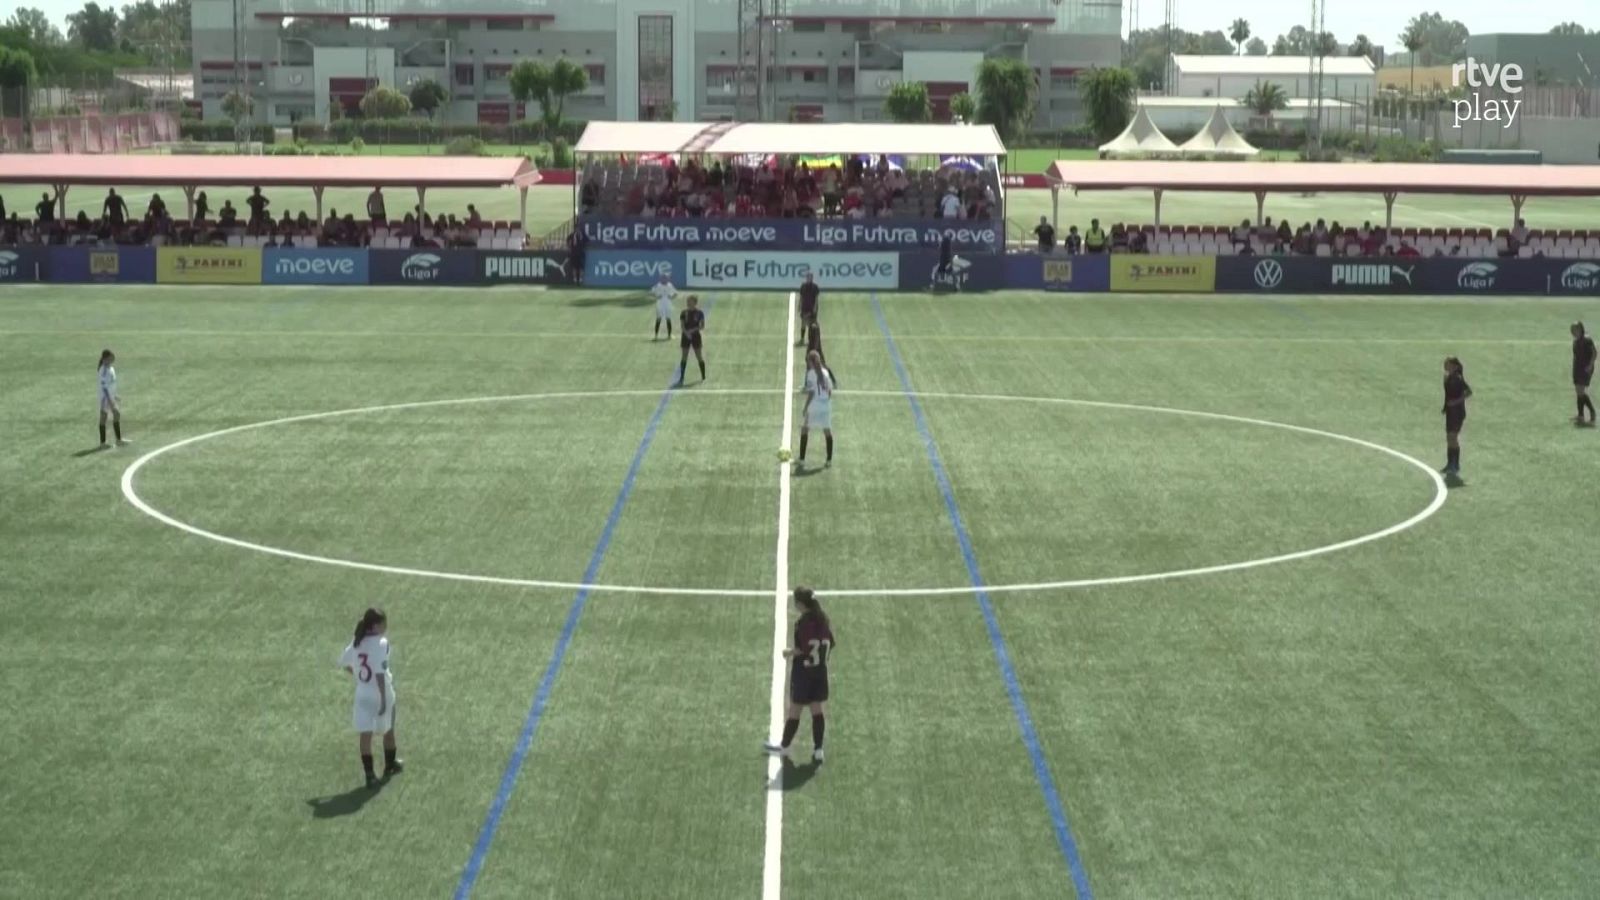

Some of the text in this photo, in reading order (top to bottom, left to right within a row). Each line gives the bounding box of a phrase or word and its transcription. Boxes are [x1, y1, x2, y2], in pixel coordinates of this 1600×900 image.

[585, 223, 776, 244] Liga Futura moeve
[803, 224, 847, 245] Liga
[852, 225, 917, 242] Futura
[193, 258, 243, 267] PANINI
[275, 257, 354, 274] moeve
[485, 256, 544, 277] PUMA
[594, 260, 672, 276] moeve
[692, 259, 892, 280] Liga Futura moeve
[1147, 266, 1197, 275] PANINI
[408, 264, 440, 279] Liga F
[1332, 264, 1390, 285] PUMA
[1464, 277, 1496, 289] Liga F
[1568, 277, 1589, 289] Liga
[358, 653, 372, 683] 3
